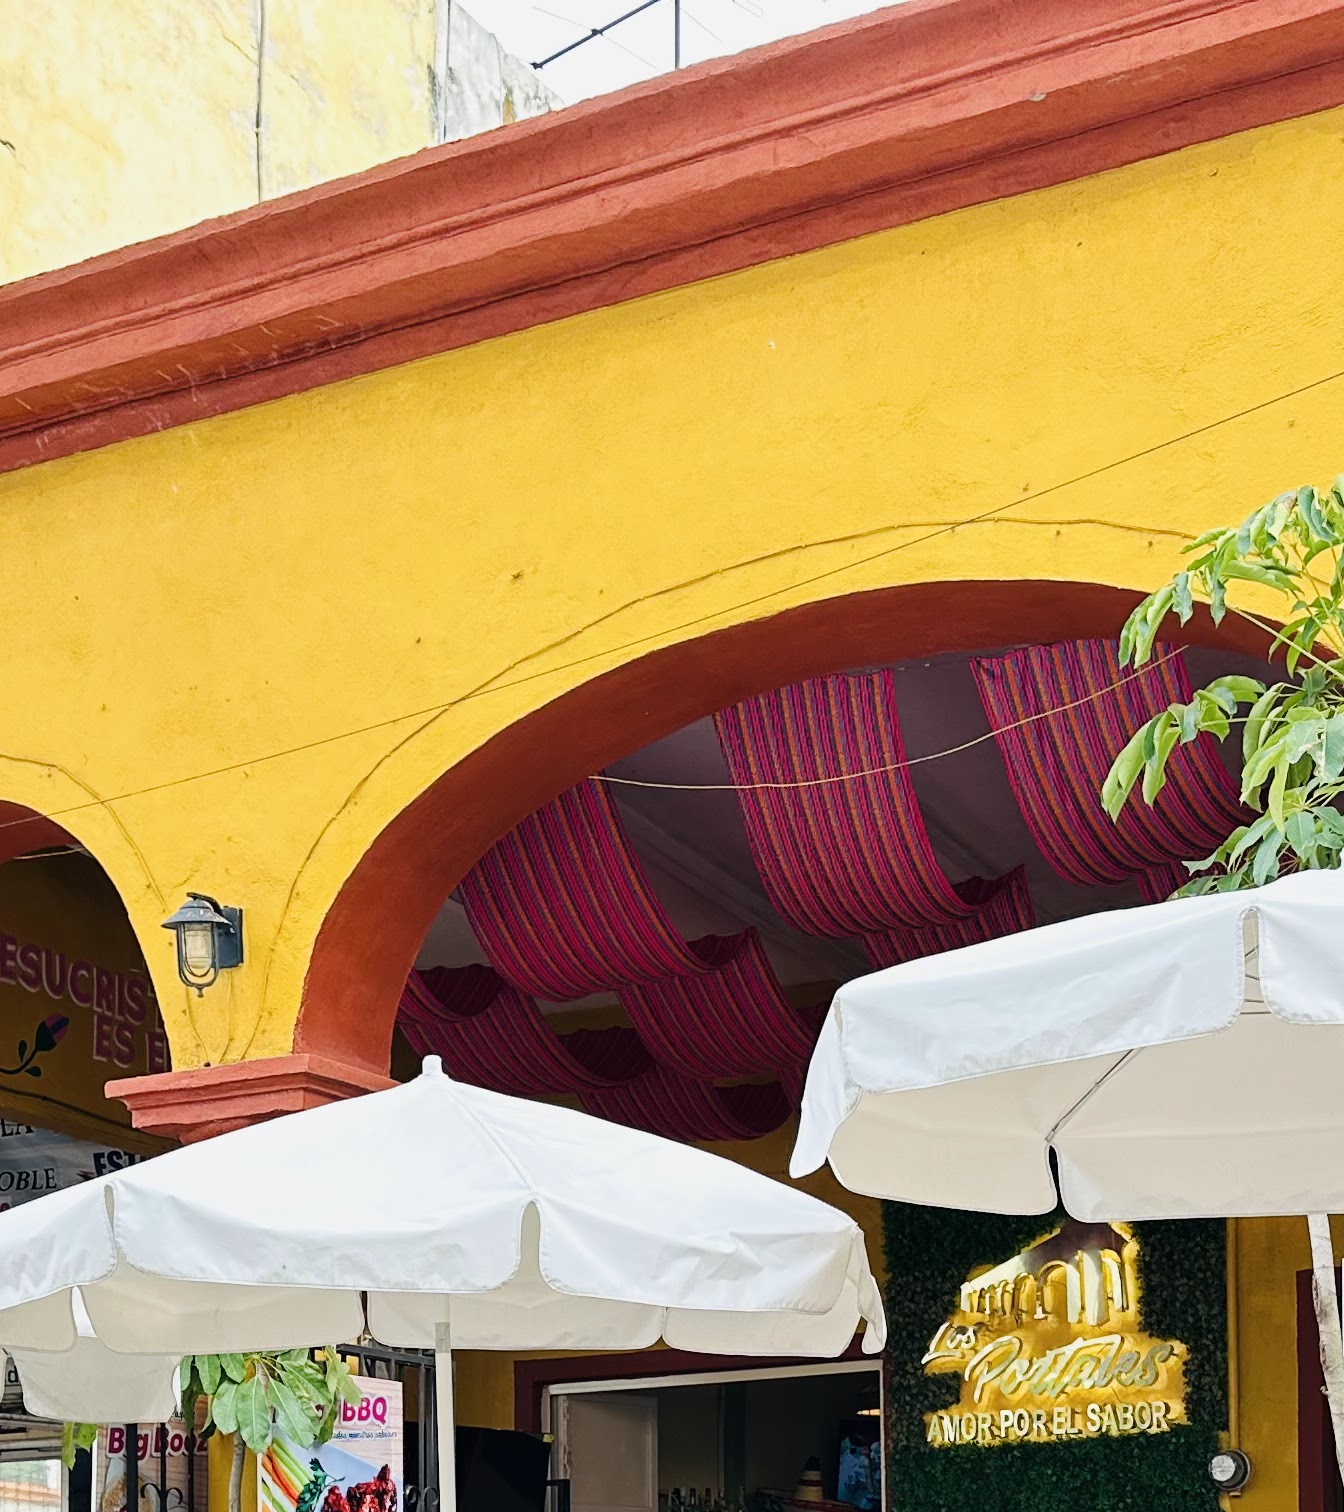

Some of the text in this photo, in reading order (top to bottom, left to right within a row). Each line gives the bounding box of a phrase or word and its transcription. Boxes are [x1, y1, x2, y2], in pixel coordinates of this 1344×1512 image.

[92, 1013, 169, 1074] ES E
[921, 1321, 978, 1365] Los
[964, 1333, 1174, 1403] Portales
[342, 1396, 388, 1425] BBQ
[926, 1400, 1170, 1443] AMOR POR EL SABOR
[108, 1427, 149, 1461] Bg
